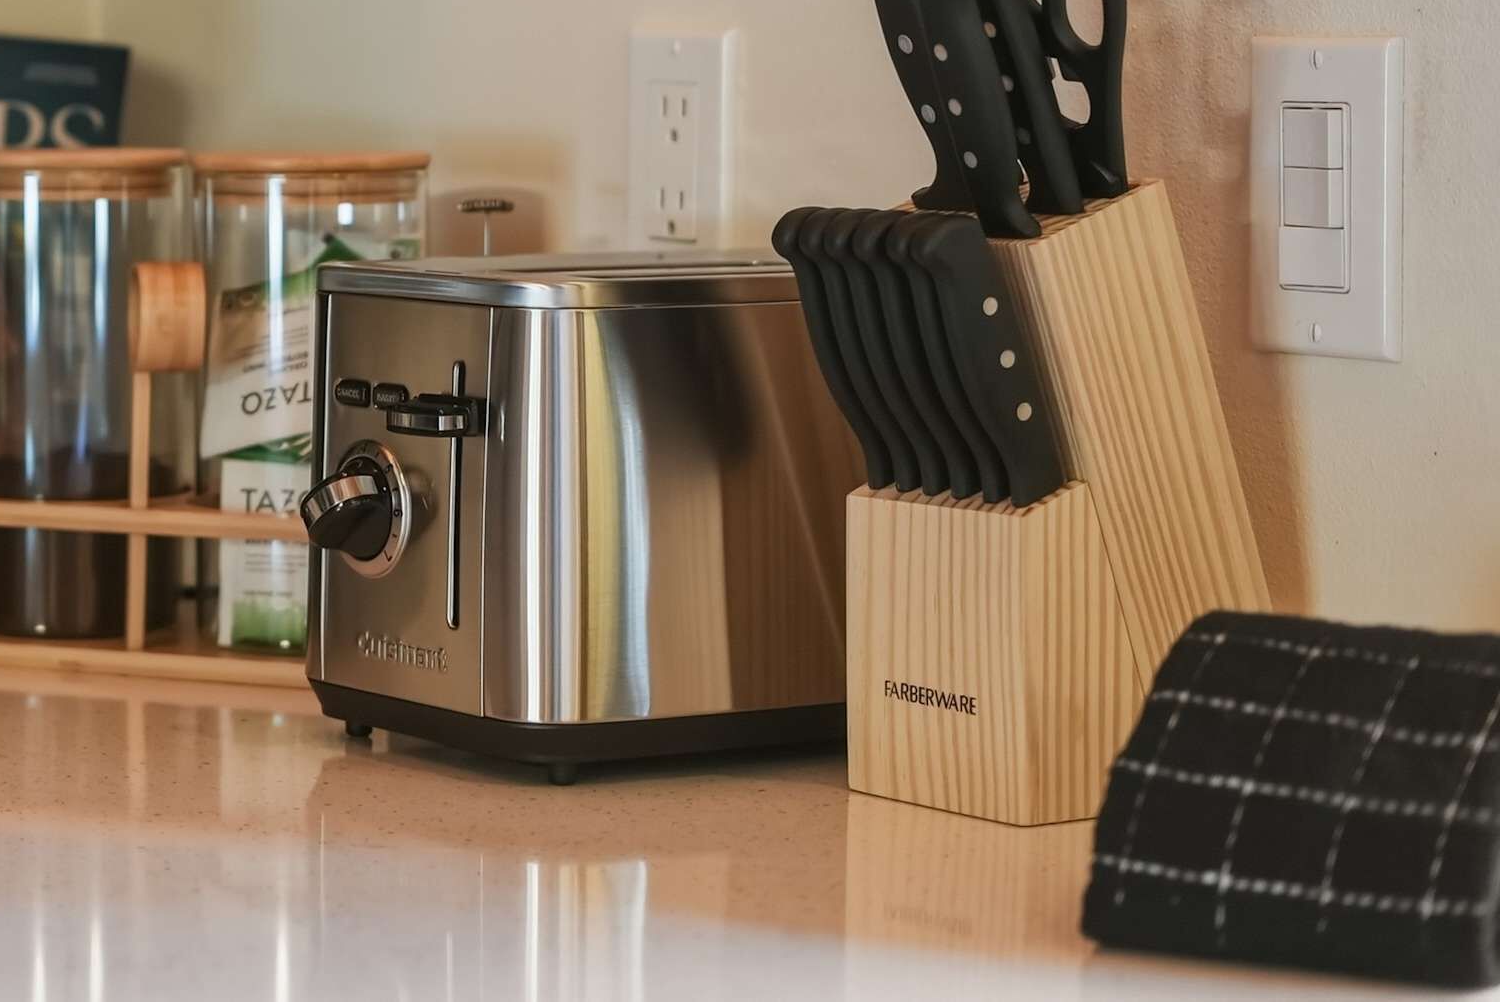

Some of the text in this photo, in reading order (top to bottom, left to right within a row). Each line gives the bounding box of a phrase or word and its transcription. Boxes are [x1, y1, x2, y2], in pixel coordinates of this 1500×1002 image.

[240, 381, 312, 415] TAZO
[240, 488, 307, 513] TAZ
[884, 679, 977, 715] FARBERWARE
